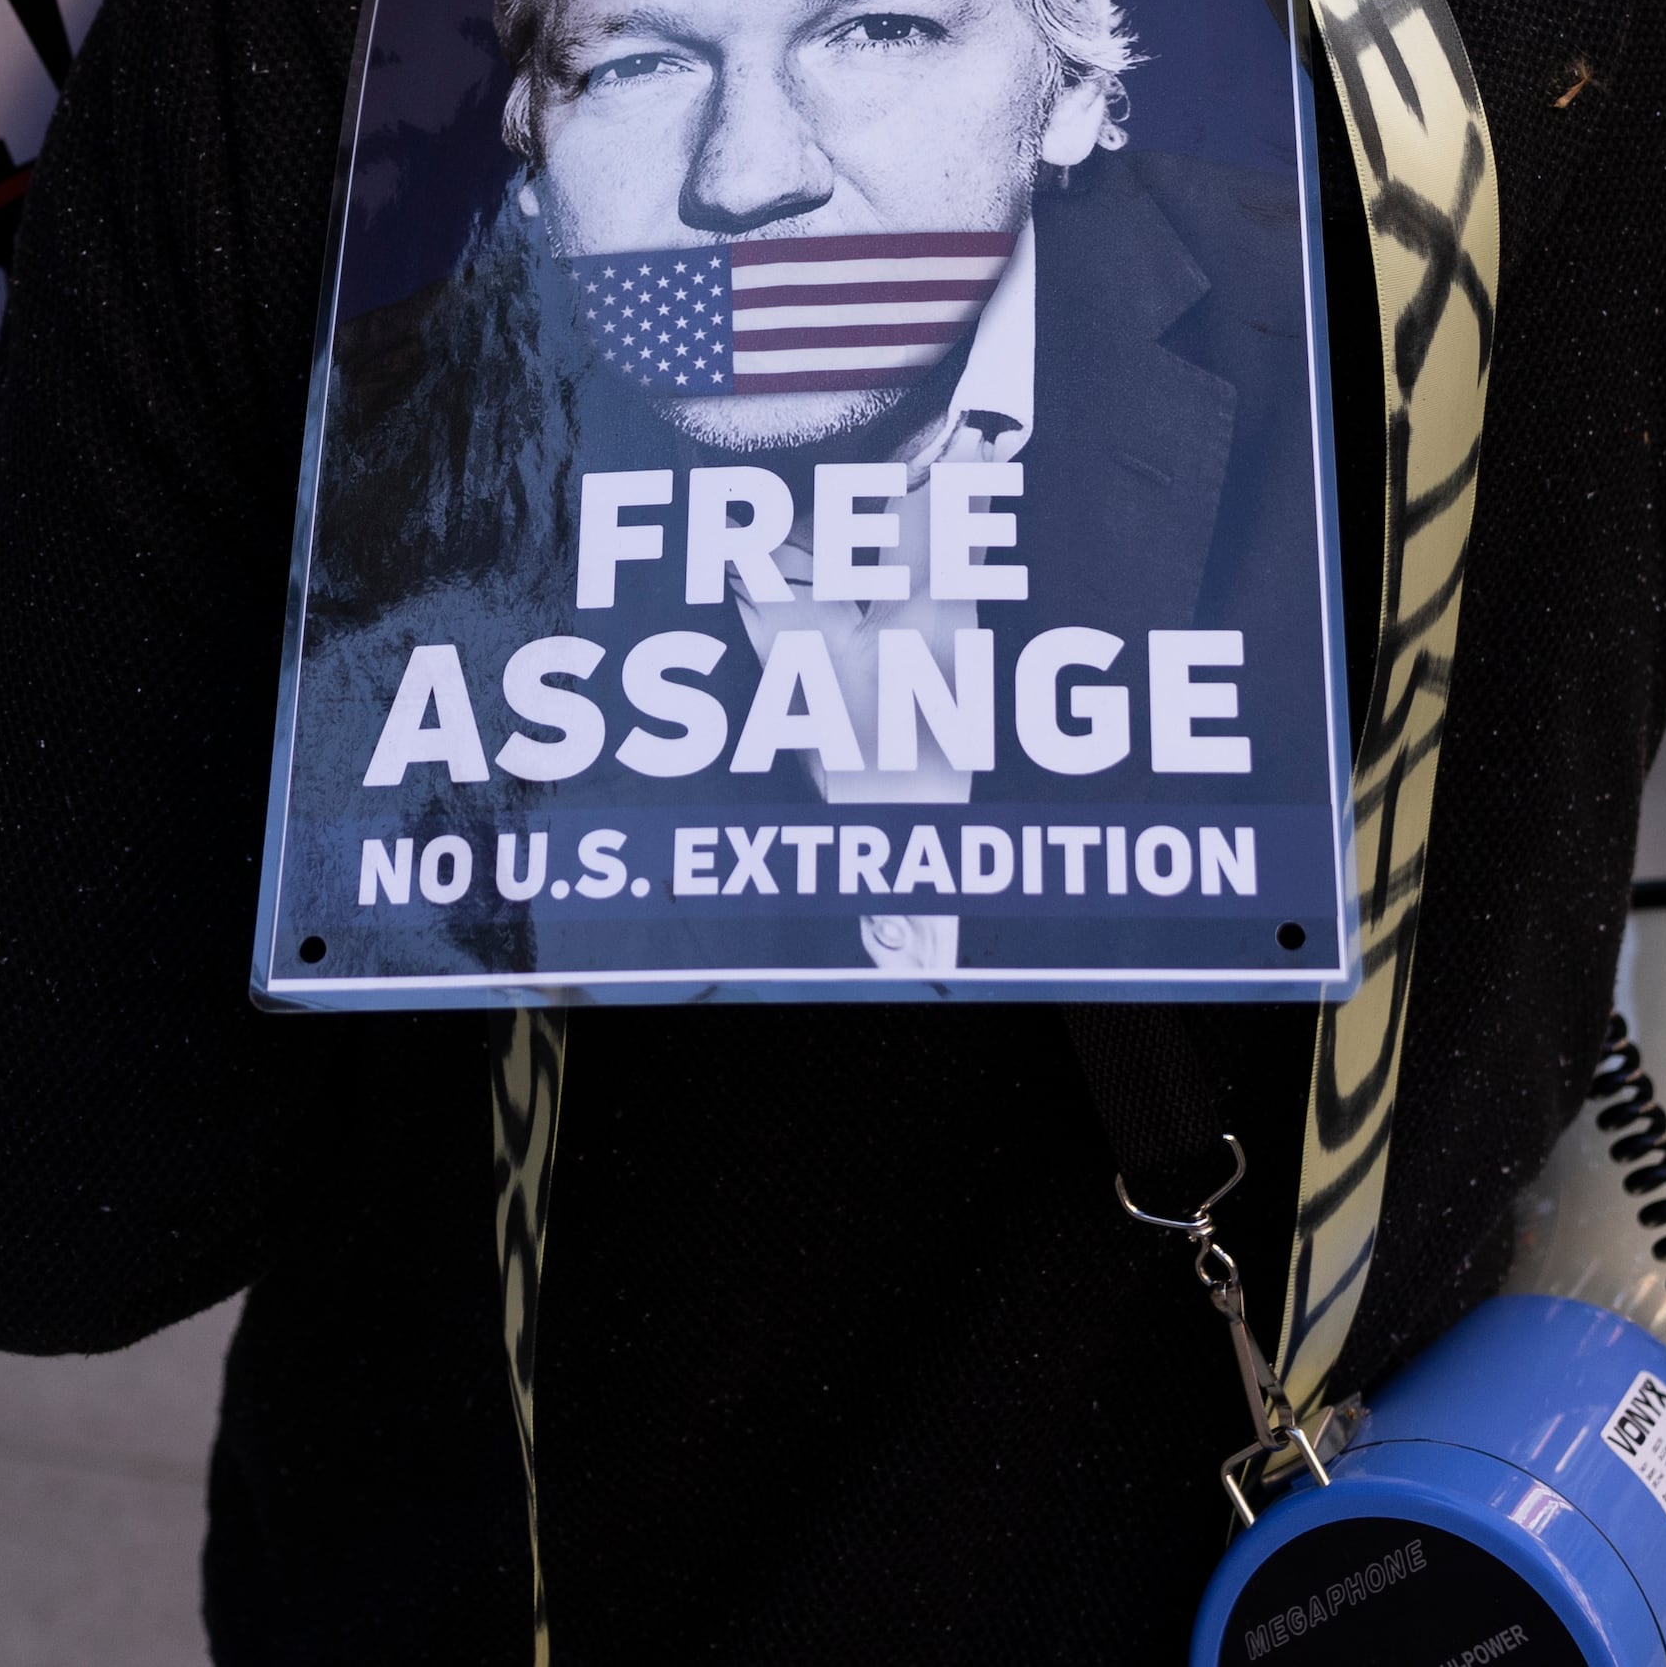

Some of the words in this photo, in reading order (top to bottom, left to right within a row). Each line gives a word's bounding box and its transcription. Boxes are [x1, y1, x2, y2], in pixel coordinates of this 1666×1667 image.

[576, 461, 1029, 610] FREE
[361, 626, 1253, 788] ASSANGE
[357, 833, 473, 906] NO
[494, 829, 652, 903] U.S.
[673, 824, 1258, 898] EXTRADITION
[1244, 1538, 1428, 1661] MEGAPHONE
